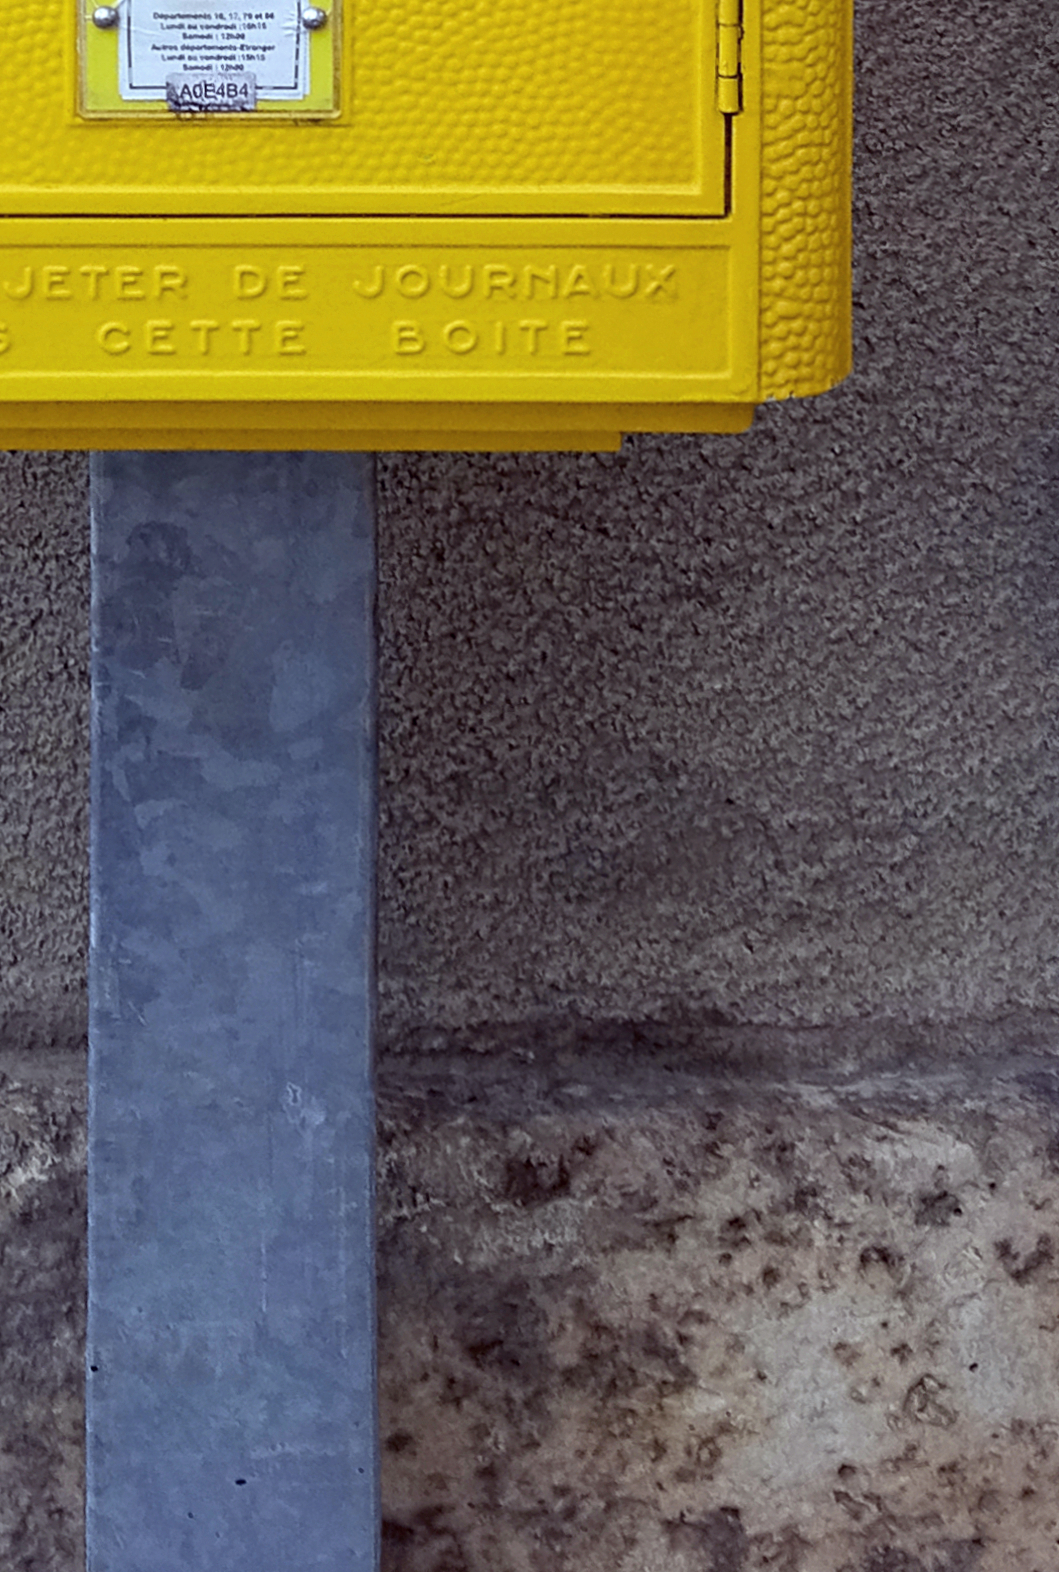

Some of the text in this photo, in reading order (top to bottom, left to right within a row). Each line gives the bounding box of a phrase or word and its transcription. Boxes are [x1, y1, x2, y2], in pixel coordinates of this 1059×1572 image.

[3, 265, 189, 301] JETER
[234, 264, 309, 300] DE
[352, 264, 679, 300] JOURNAUX
[97, 319, 308, 356] CETTE
[392, 319, 591, 356] BOITE
